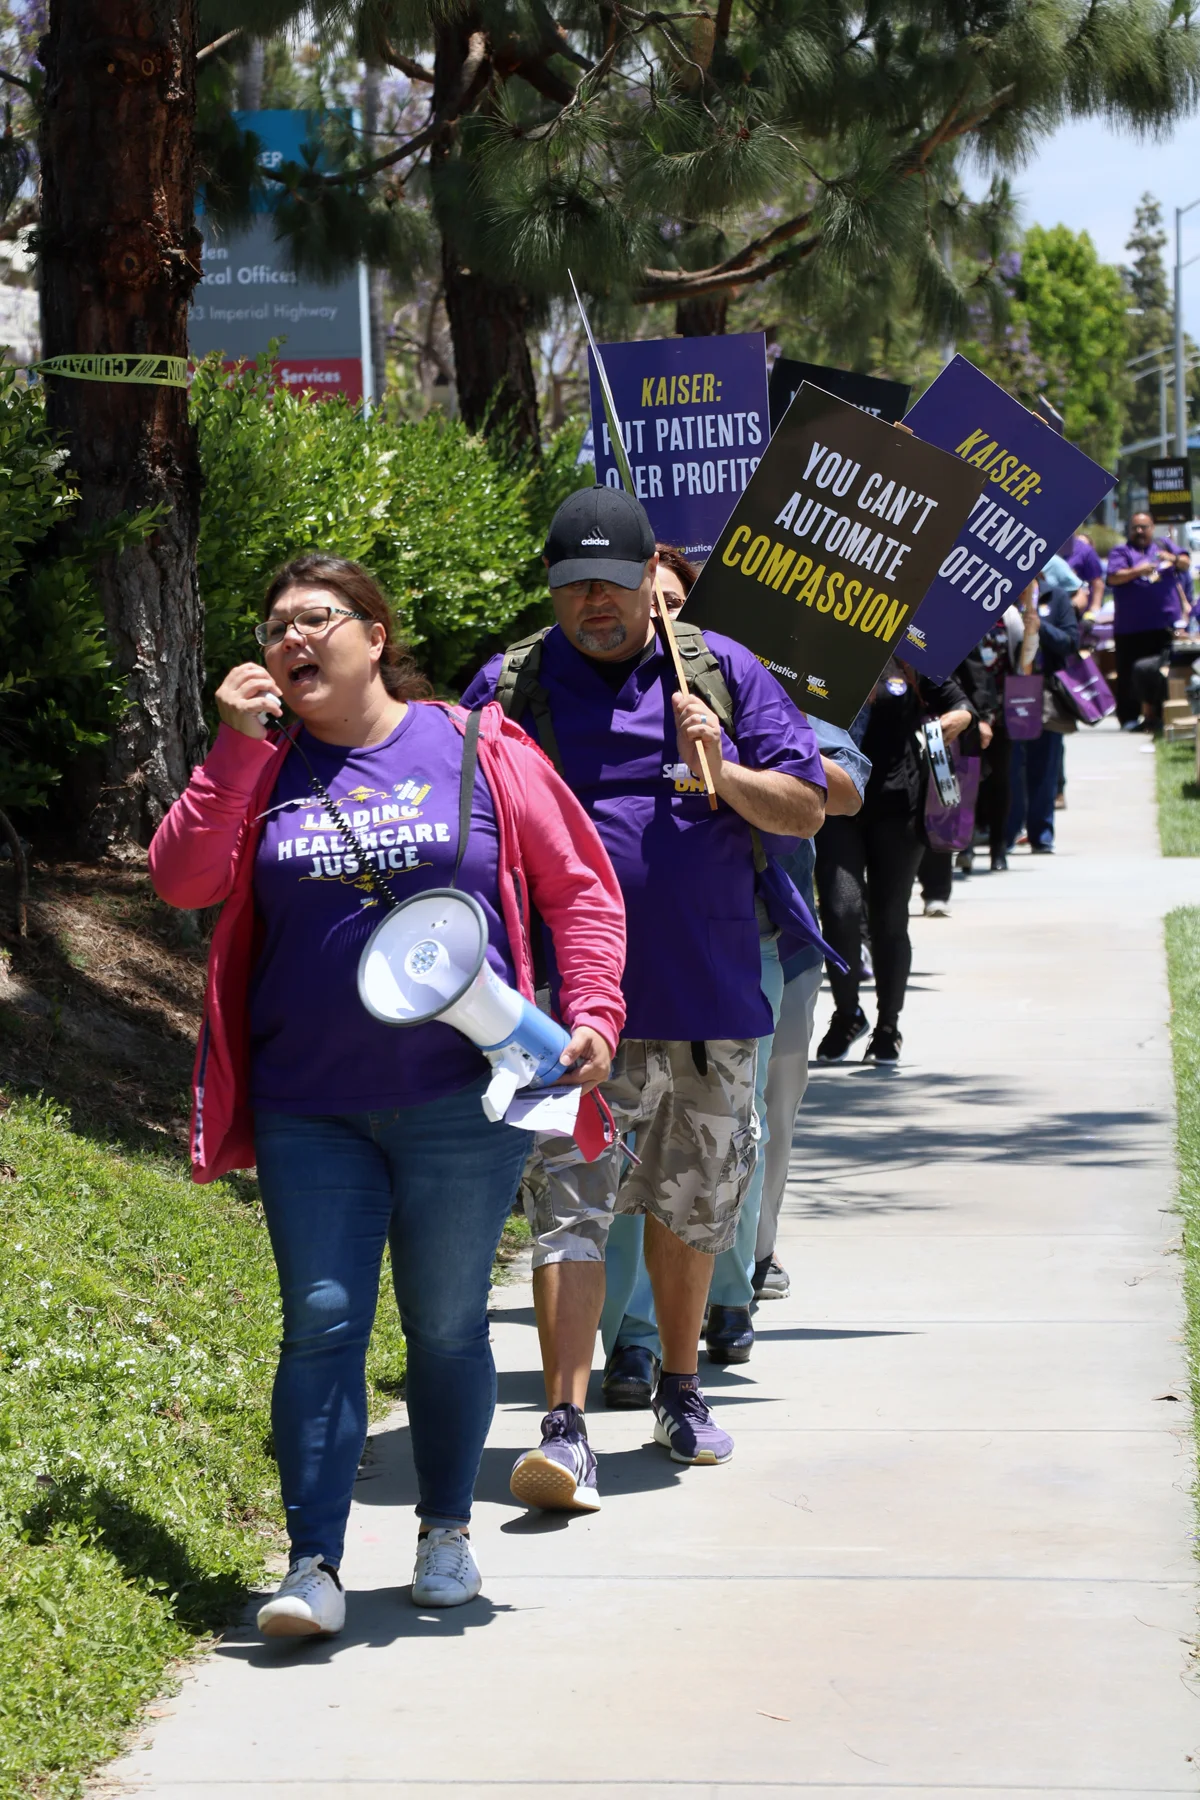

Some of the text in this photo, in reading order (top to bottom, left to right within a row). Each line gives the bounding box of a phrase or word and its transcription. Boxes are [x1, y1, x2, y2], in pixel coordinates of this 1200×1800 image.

[201, 265, 297, 285] ical Offices
[210, 302, 269, 323] Imperial
[274, 302, 338, 322] Highway
[281, 367, 341, 384] Services
[641, 373, 722, 407] KAISER:
[655, 411, 762, 452] PATIENTS
[605, 465, 664, 499] OER
[955, 428, 1043, 506] KAISER:
[802, 441, 939, 535] YOU CAN'T
[581, 537, 610, 547] adidas
[774, 491, 912, 582] AUTOMATE
[967, 493, 1047, 571] TIENTS
[721, 525, 909, 643] COMPASSION
[938, 546, 1013, 612] OFITS
[662, 763, 699, 779] SEI
[675, 778, 706, 792] UH
[303, 804, 419, 828] LEADING
[278, 823, 451, 861] HEALHCARE
